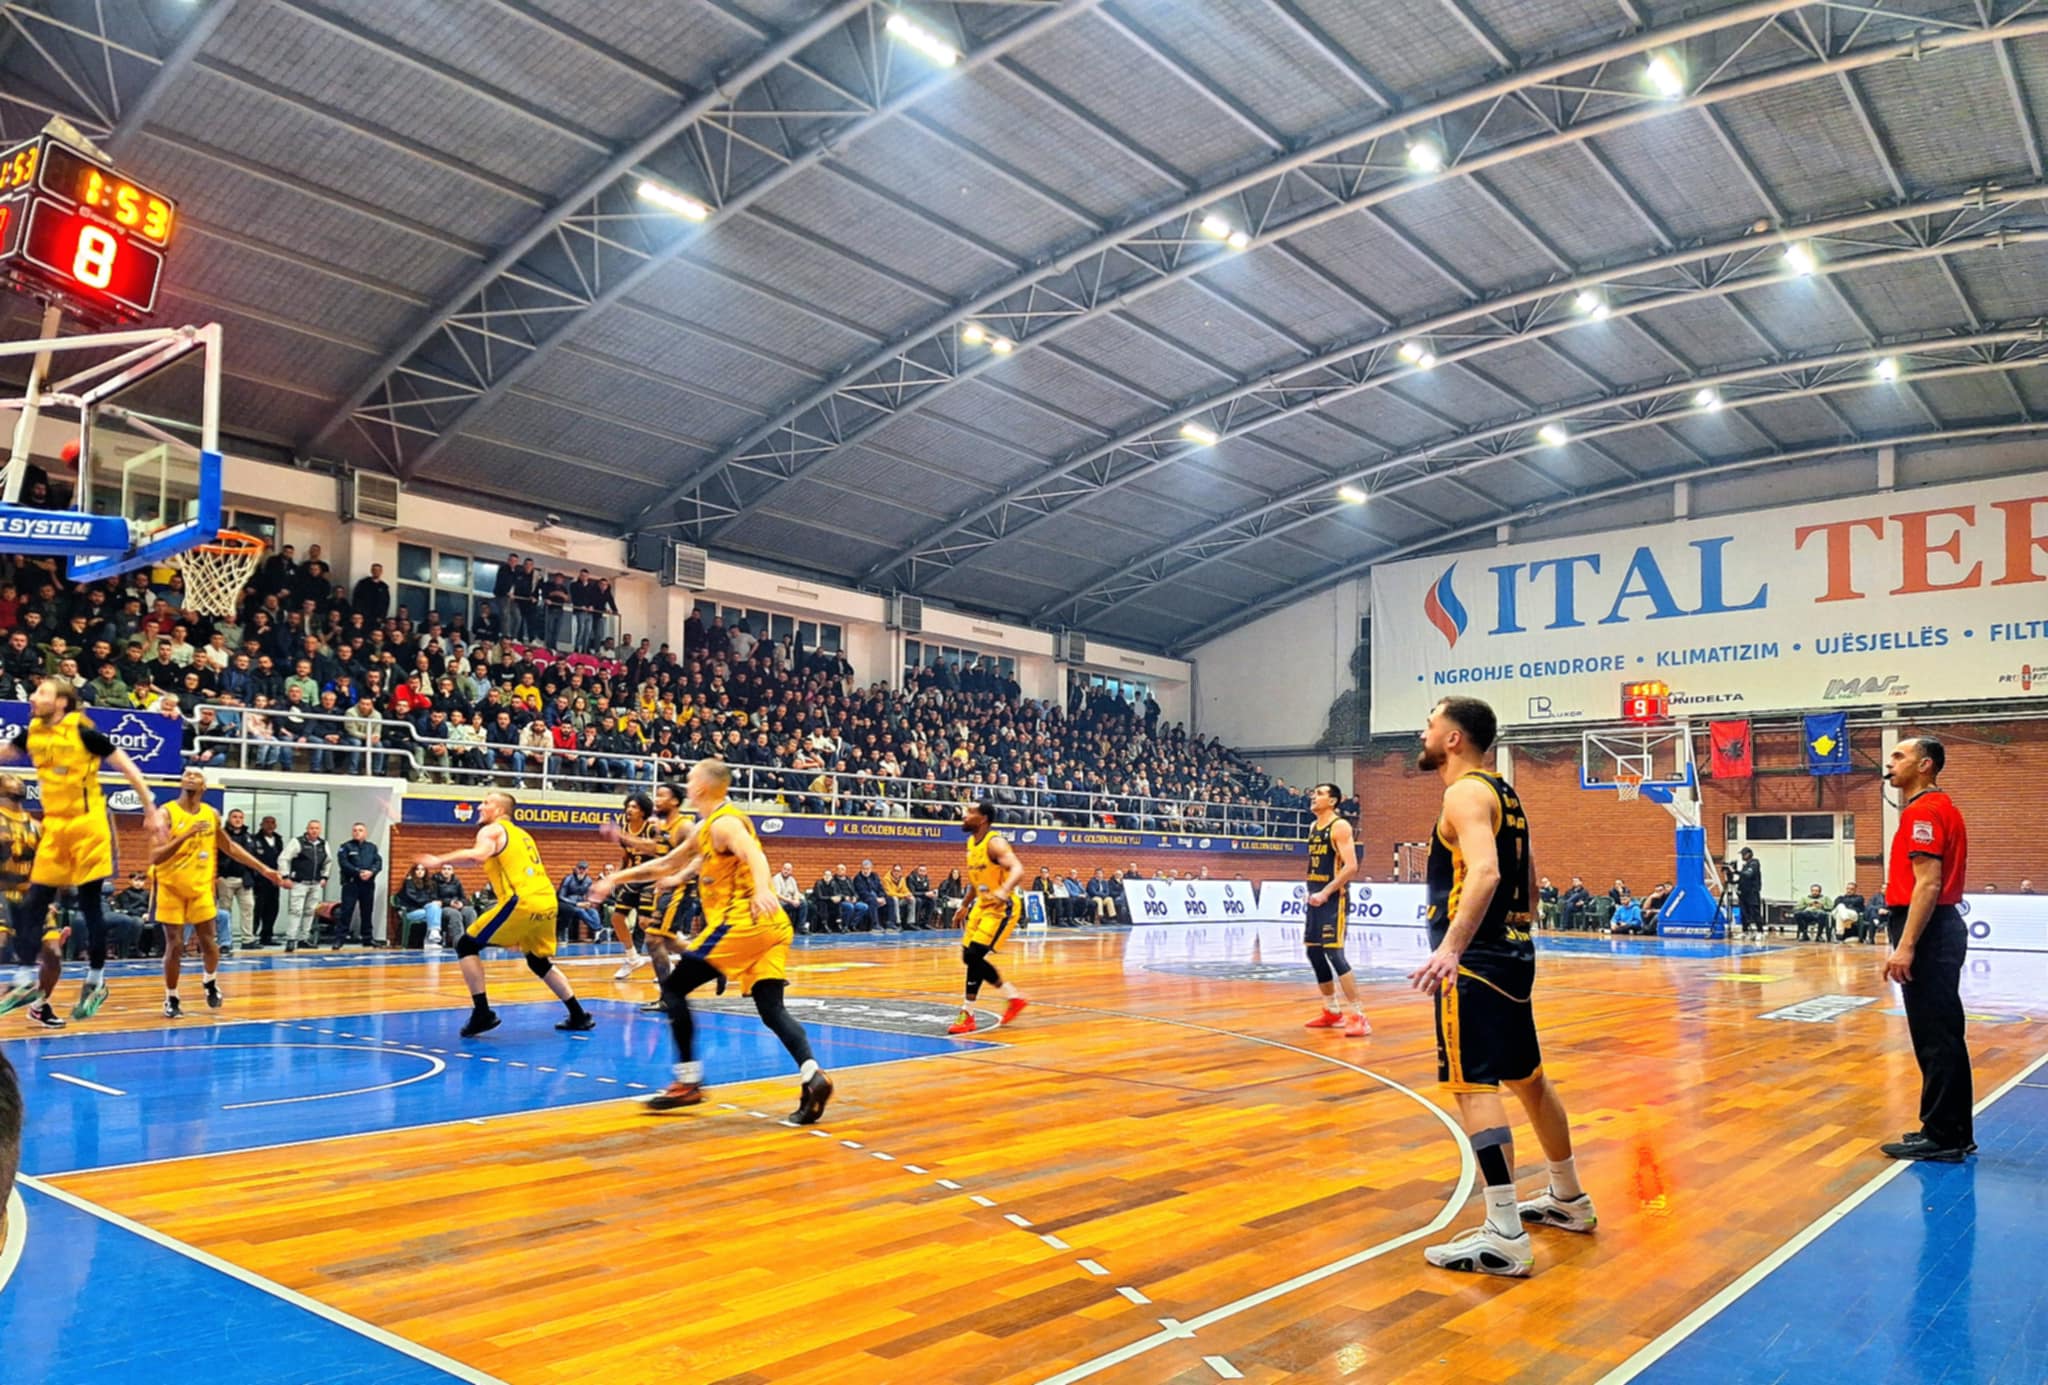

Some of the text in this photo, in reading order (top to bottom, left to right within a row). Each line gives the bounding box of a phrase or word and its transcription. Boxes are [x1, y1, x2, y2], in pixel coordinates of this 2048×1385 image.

[86, 169, 169, 238] 1:53
[73, 225, 117, 289] 8
[8, 518, 92, 538] SYSTEM
[1488, 536, 1768, 635] ITAL
[1434, 664, 1514, 685] NGROHJE
[1520, 655, 1625, 678] QENDRORE
[1657, 643, 1779, 666] KLIMATIZIM
[1816, 626, 1948, 655] UJËSJELLËS
[1635, 700, 1646, 717] 9
[514, 809, 568, 823] GOLDEN
[571, 812, 611, 825] EAGLE
[842, 823, 860, 834] K.B.
[861, 824, 896, 835] GOLDEN
[897, 825, 923, 836] EAGLE
[1144, 900, 1168, 915] PRO
[1184, 900, 1207, 914] PRO
[1223, 900, 1245, 914] PRO
